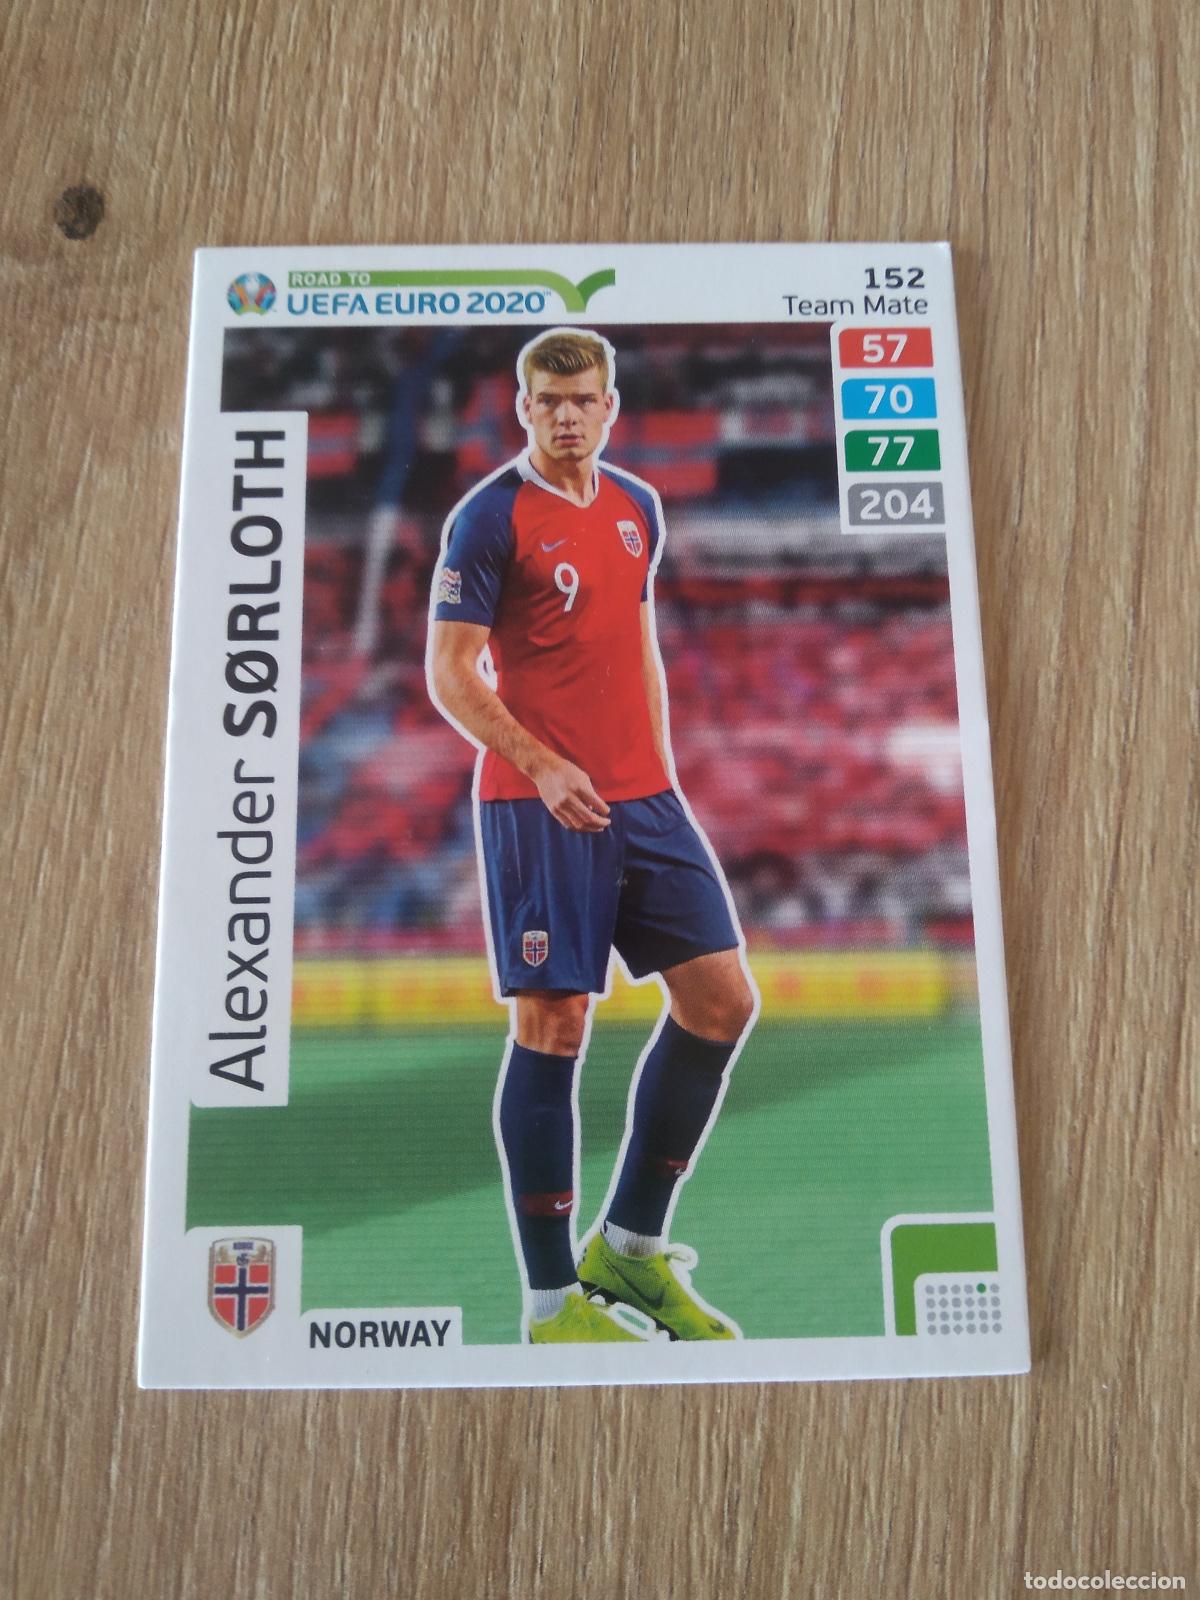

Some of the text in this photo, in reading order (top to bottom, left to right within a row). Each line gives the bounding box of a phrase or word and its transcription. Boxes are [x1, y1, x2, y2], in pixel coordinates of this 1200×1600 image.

[290, 272, 371, 286] ROAD TO
[864, 268, 925, 289] 152
[287, 291, 545, 315] UEFA EURO 2020
[782, 295, 928, 315] Team Mate
[862, 334, 908, 363] 57
[864, 384, 914, 414] 70
[867, 436, 915, 466] 77
[859, 488, 934, 520] 204
[554, 562, 579, 612] 9
[208, 430, 285, 1092] Alexander SØRLOTH
[309, 1320, 451, 1348] NORWAY
